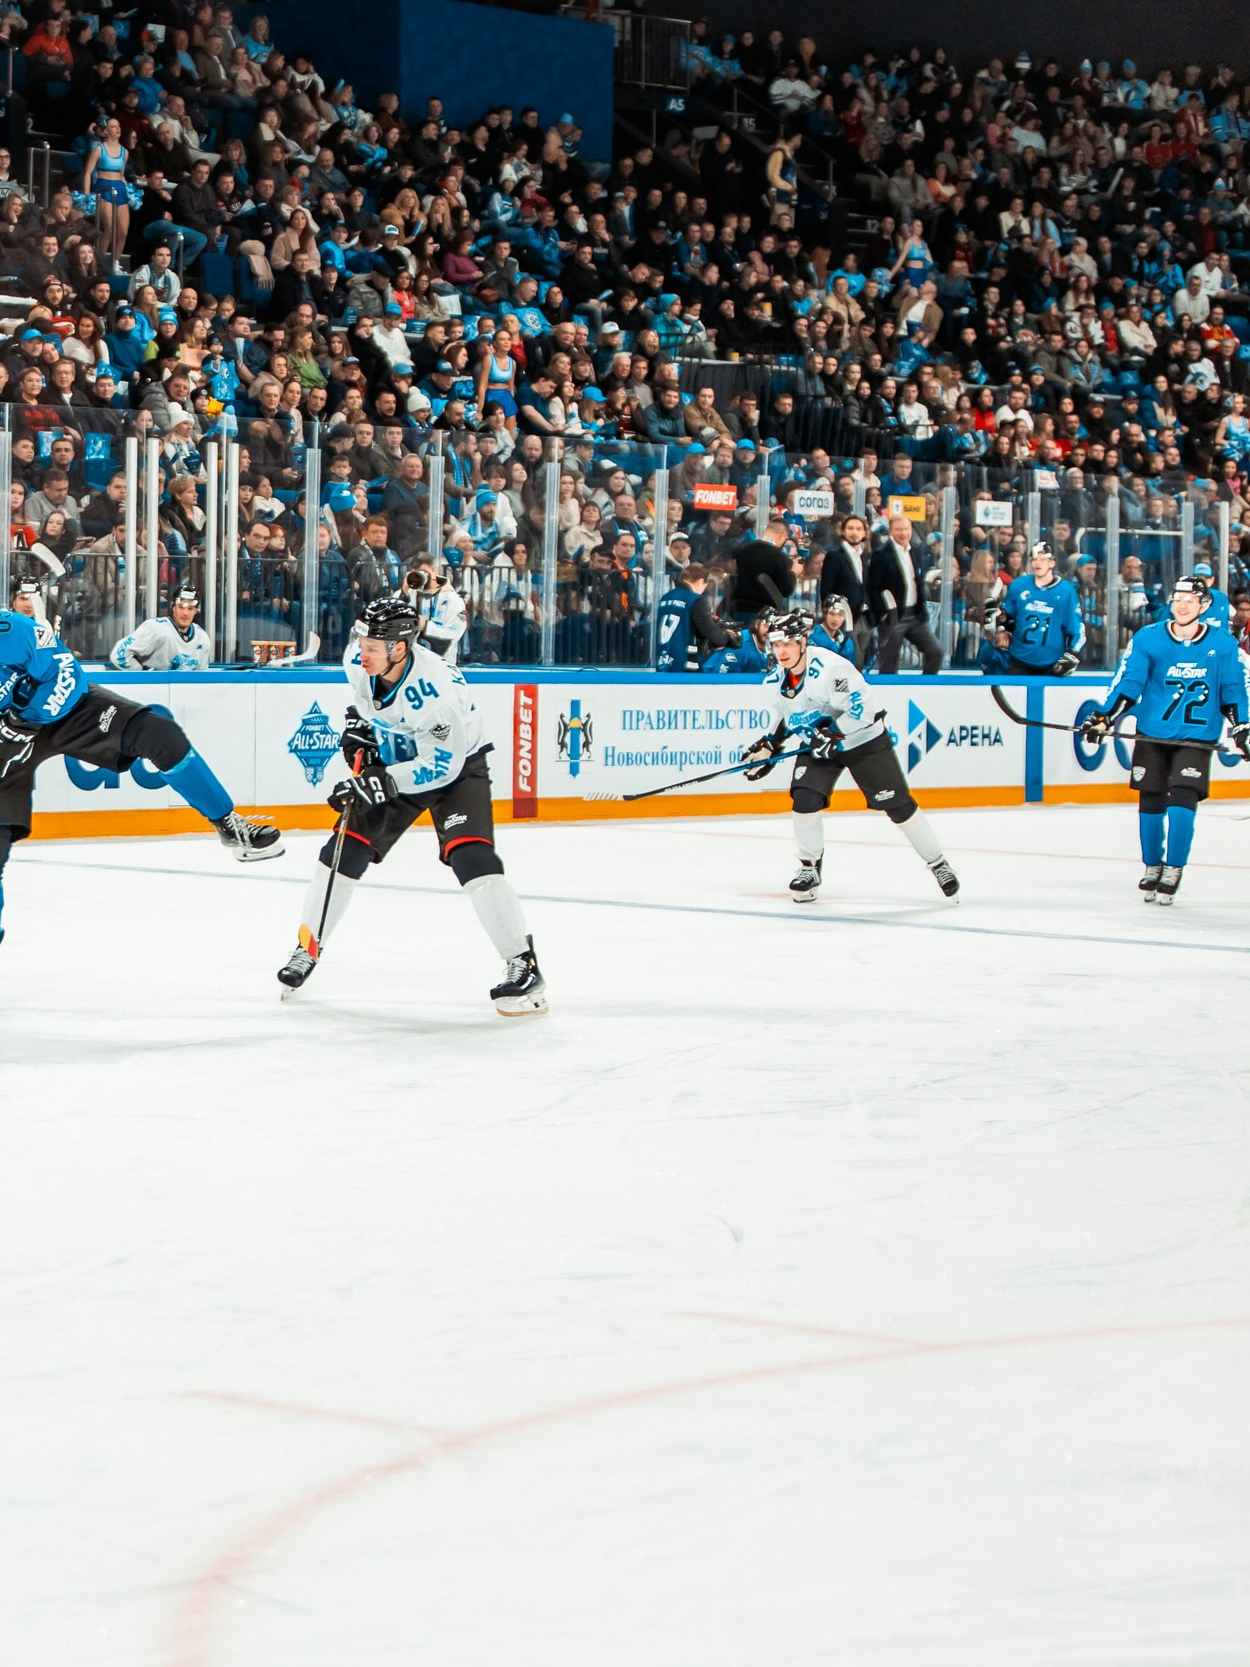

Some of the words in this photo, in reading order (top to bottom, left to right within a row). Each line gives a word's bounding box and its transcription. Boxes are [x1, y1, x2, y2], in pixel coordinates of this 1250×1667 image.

[695, 490, 736, 506] FONBET
[1022, 613, 1051, 647] 21
[808, 657, 824, 679] 97
[404, 678, 440, 711] 94
[1161, 679, 1209, 727] 72
[621, 708, 771, 731] ПРАВИТЕЛЬСТВО
[518, 690, 535, 793] FONBET
[946, 725, 1004, 747] АРЕНА
[604, 744, 722, 771] Новосибирской
